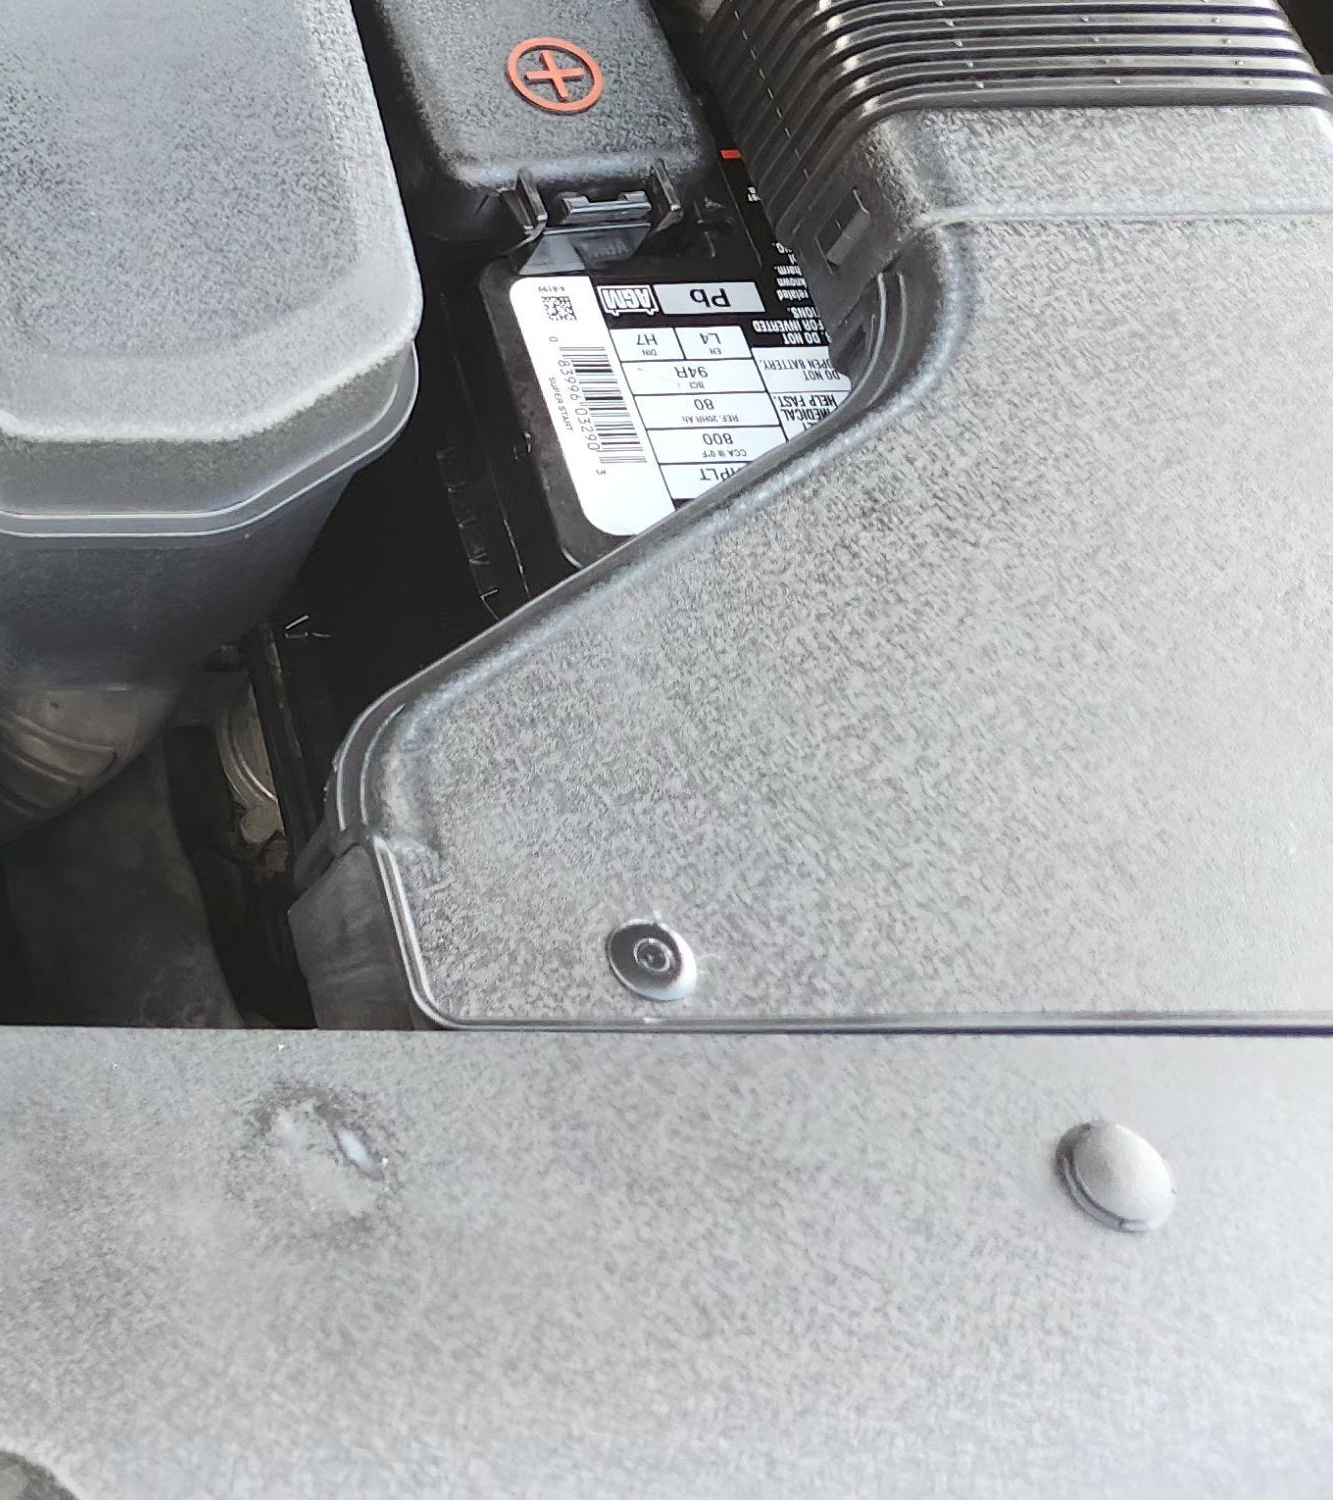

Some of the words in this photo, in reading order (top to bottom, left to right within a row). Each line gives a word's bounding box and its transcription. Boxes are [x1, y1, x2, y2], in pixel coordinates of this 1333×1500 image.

[774, 265, 803, 276] harm.
[602, 288, 653, 310] AGM
[689, 288, 732, 308] Pb
[776, 289, 809, 302] related
[752, 319, 802, 333] INVERTED
[802, 319, 825, 332] FOR
[636, 333, 658, 346] H7
[699, 332, 721, 345] L4
[781, 332, 804, 345] NOT
[803, 332, 822, 345] DO
[759, 359, 806, 371] BATTERY.
[674, 366, 709, 378] 94R
[802, 370, 825, 381] NOT
[824, 370, 841, 381] DO
[548, 376, 564, 404] SUPER
[559, 405, 574, 431] START
[557, 359, 580, 401] 83996
[574, 407, 601, 451] 03290
[693, 398, 715, 411] 80
[773, 394, 806, 408] FAST.
[809, 394, 839, 409] HELP
[780, 408, 831, 422] MEDICAL
[702, 432, 734, 446] 800
